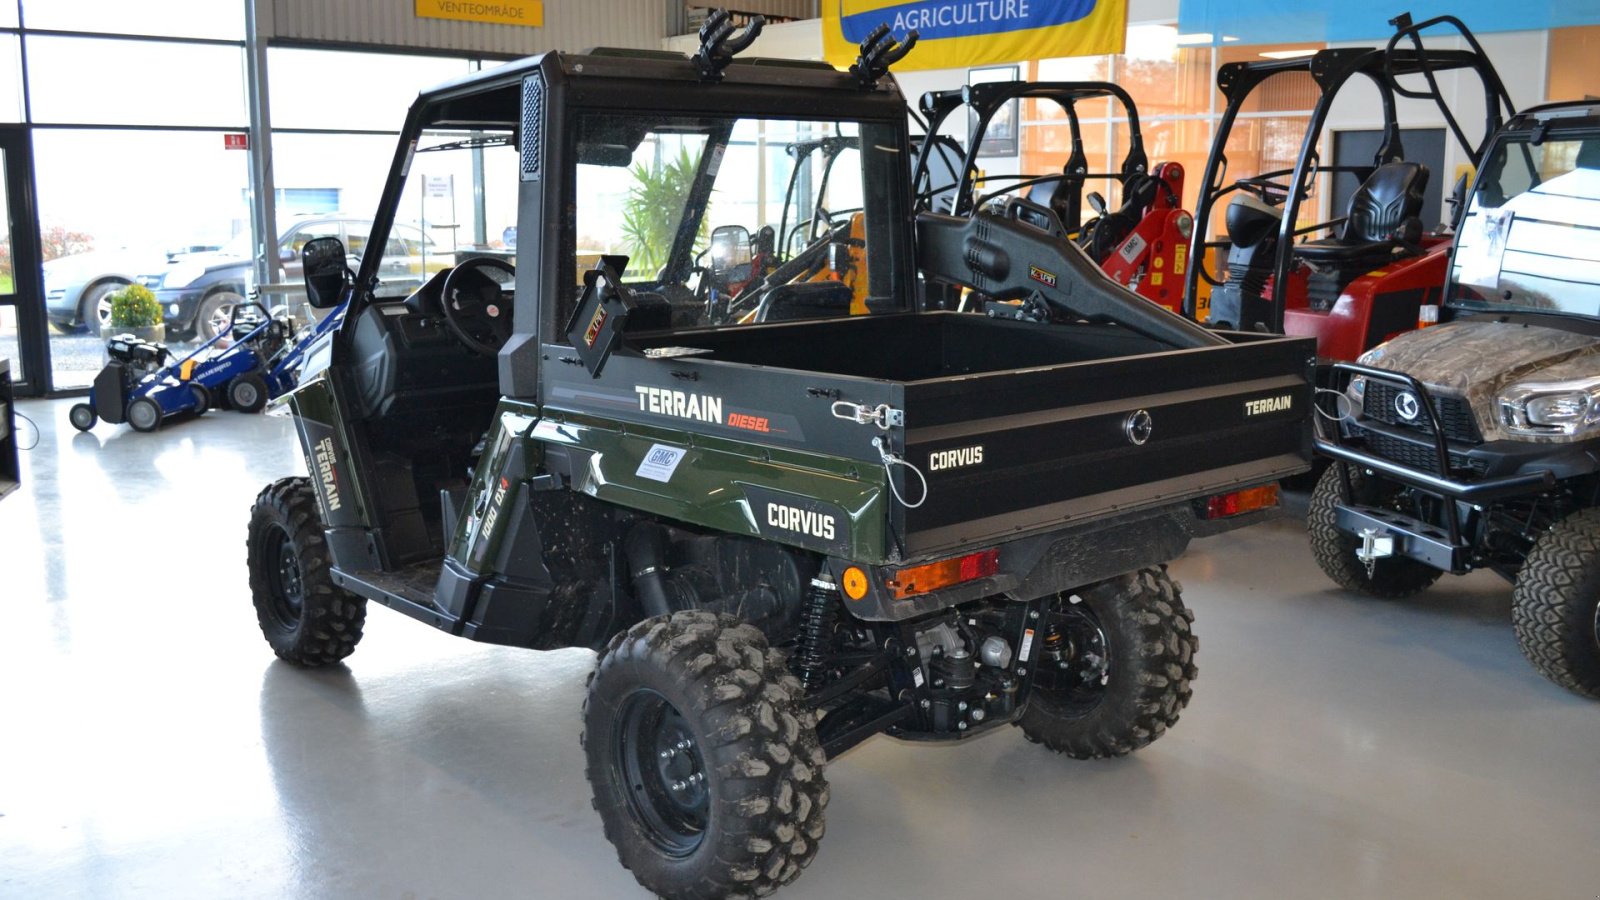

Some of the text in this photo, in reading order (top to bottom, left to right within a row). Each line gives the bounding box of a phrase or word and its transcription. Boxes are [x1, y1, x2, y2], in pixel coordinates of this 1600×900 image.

[438, 1, 525, 19] VENTEOMRÅDE
[893, 0, 1029, 32] AGRICULTURE
[635, 385, 770, 433] TERRAIN DIESEL
[1245, 395, 1292, 416] TERRAIN
[324, 437, 337, 465] CORVUS
[651, 450, 674, 465] GMC
[929, 446, 983, 471] CORVUS
[314, 440, 341, 511] TERRAIN
[482, 476, 510, 540] 1000 DX4
[767, 502, 835, 540] CORVUS
